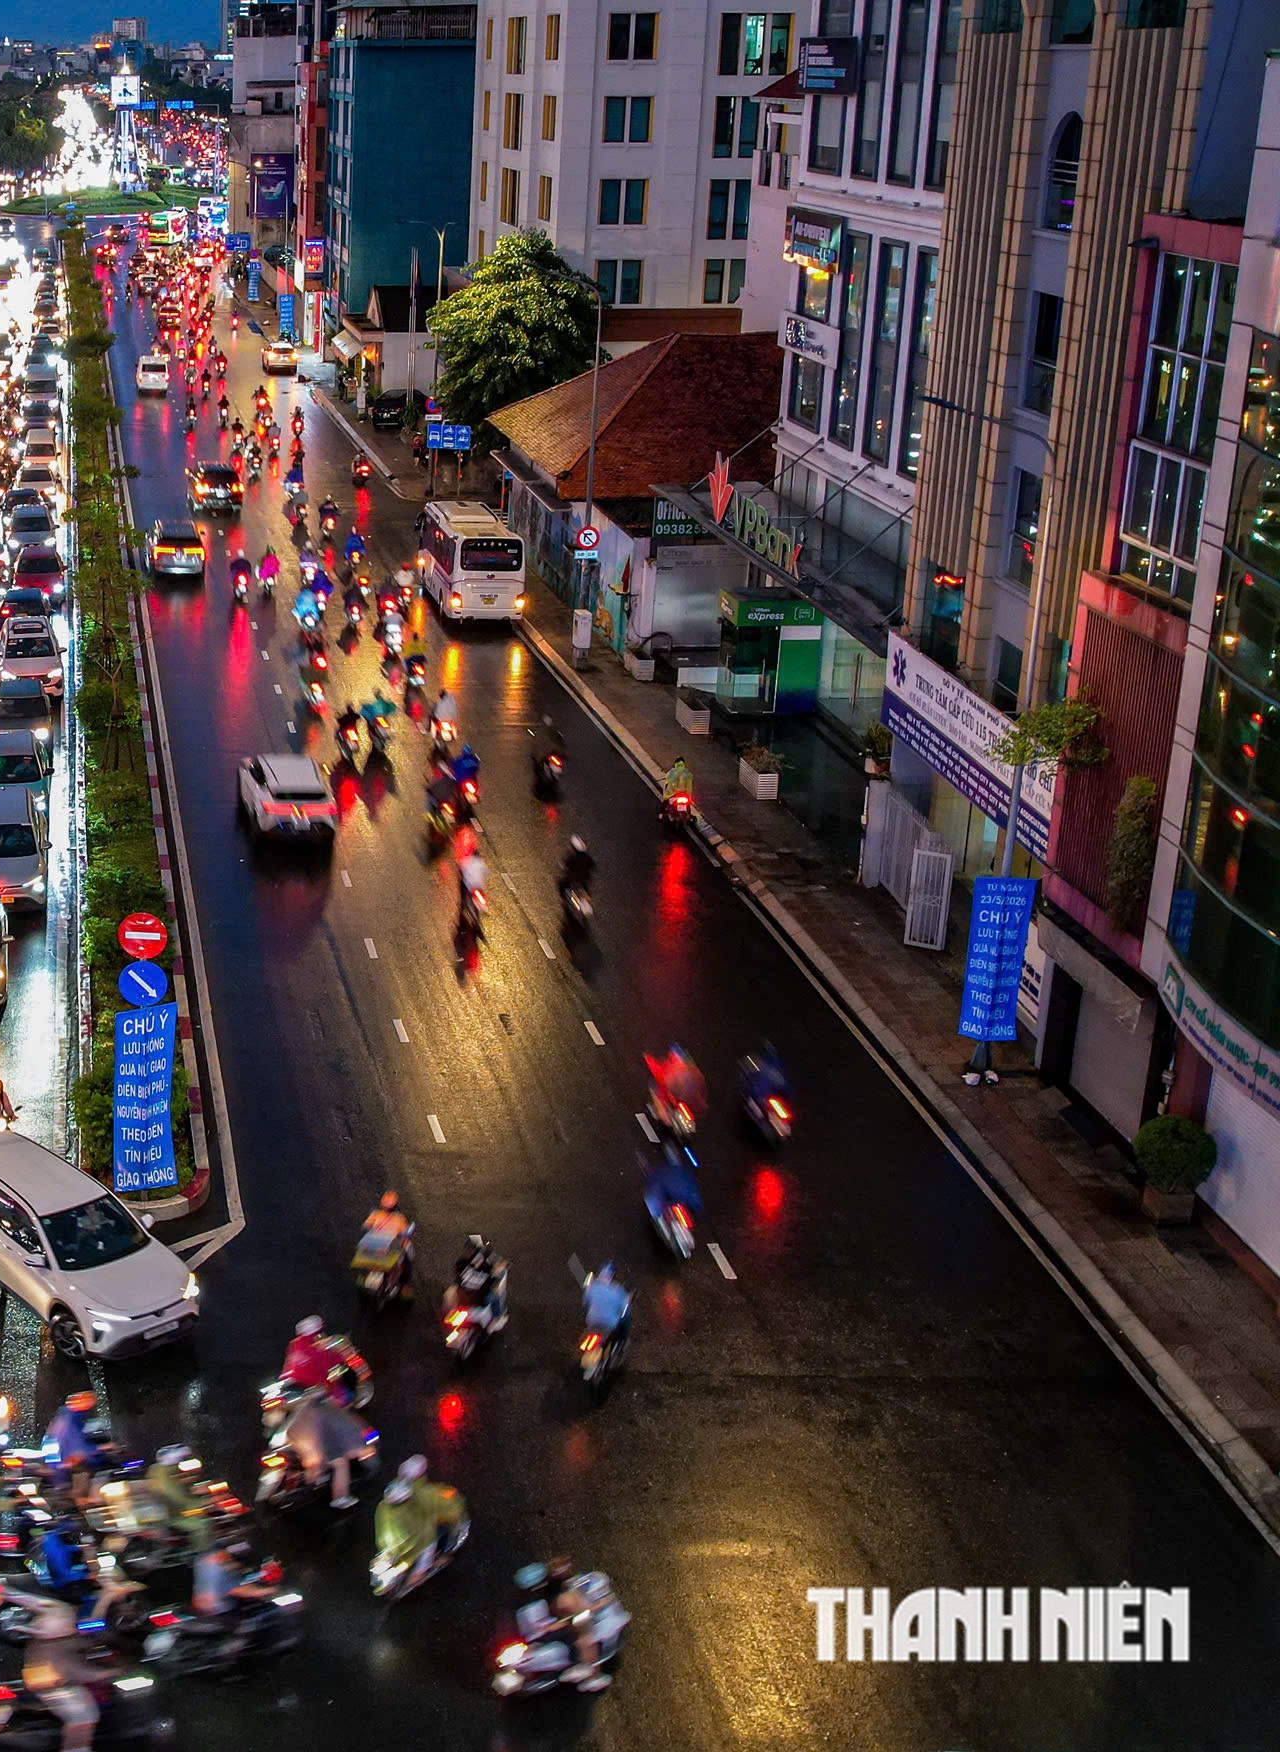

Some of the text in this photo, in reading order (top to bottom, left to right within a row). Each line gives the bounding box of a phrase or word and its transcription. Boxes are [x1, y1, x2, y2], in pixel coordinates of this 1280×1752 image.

[730, 489, 803, 580] VPBank
[748, 613, 785, 622] eXpress
[916, 674, 934, 700] TRUNG
[935, 688, 947, 711] TÂM
[949, 696, 961, 719] CẤP
[975, 721, 987, 742] 115
[971, 990, 992, 1005] THEO
[123, 1009, 169, 1035] CHÚ Ý
[962, 1021, 982, 1035] GIAO
[123, 1042, 141, 1055] LƯU
[120, 1063, 137, 1076] QUA
[151, 1058, 167, 1073] GIAO
[118, 1082, 136, 1100] ĐIỆN
[117, 1101, 141, 1120] NGUYỄN
[121, 1128, 147, 1143] THEO
[125, 1145, 162, 1165] TÍN HIỆU
[117, 1167, 174, 1188] GIAO THÔNG
